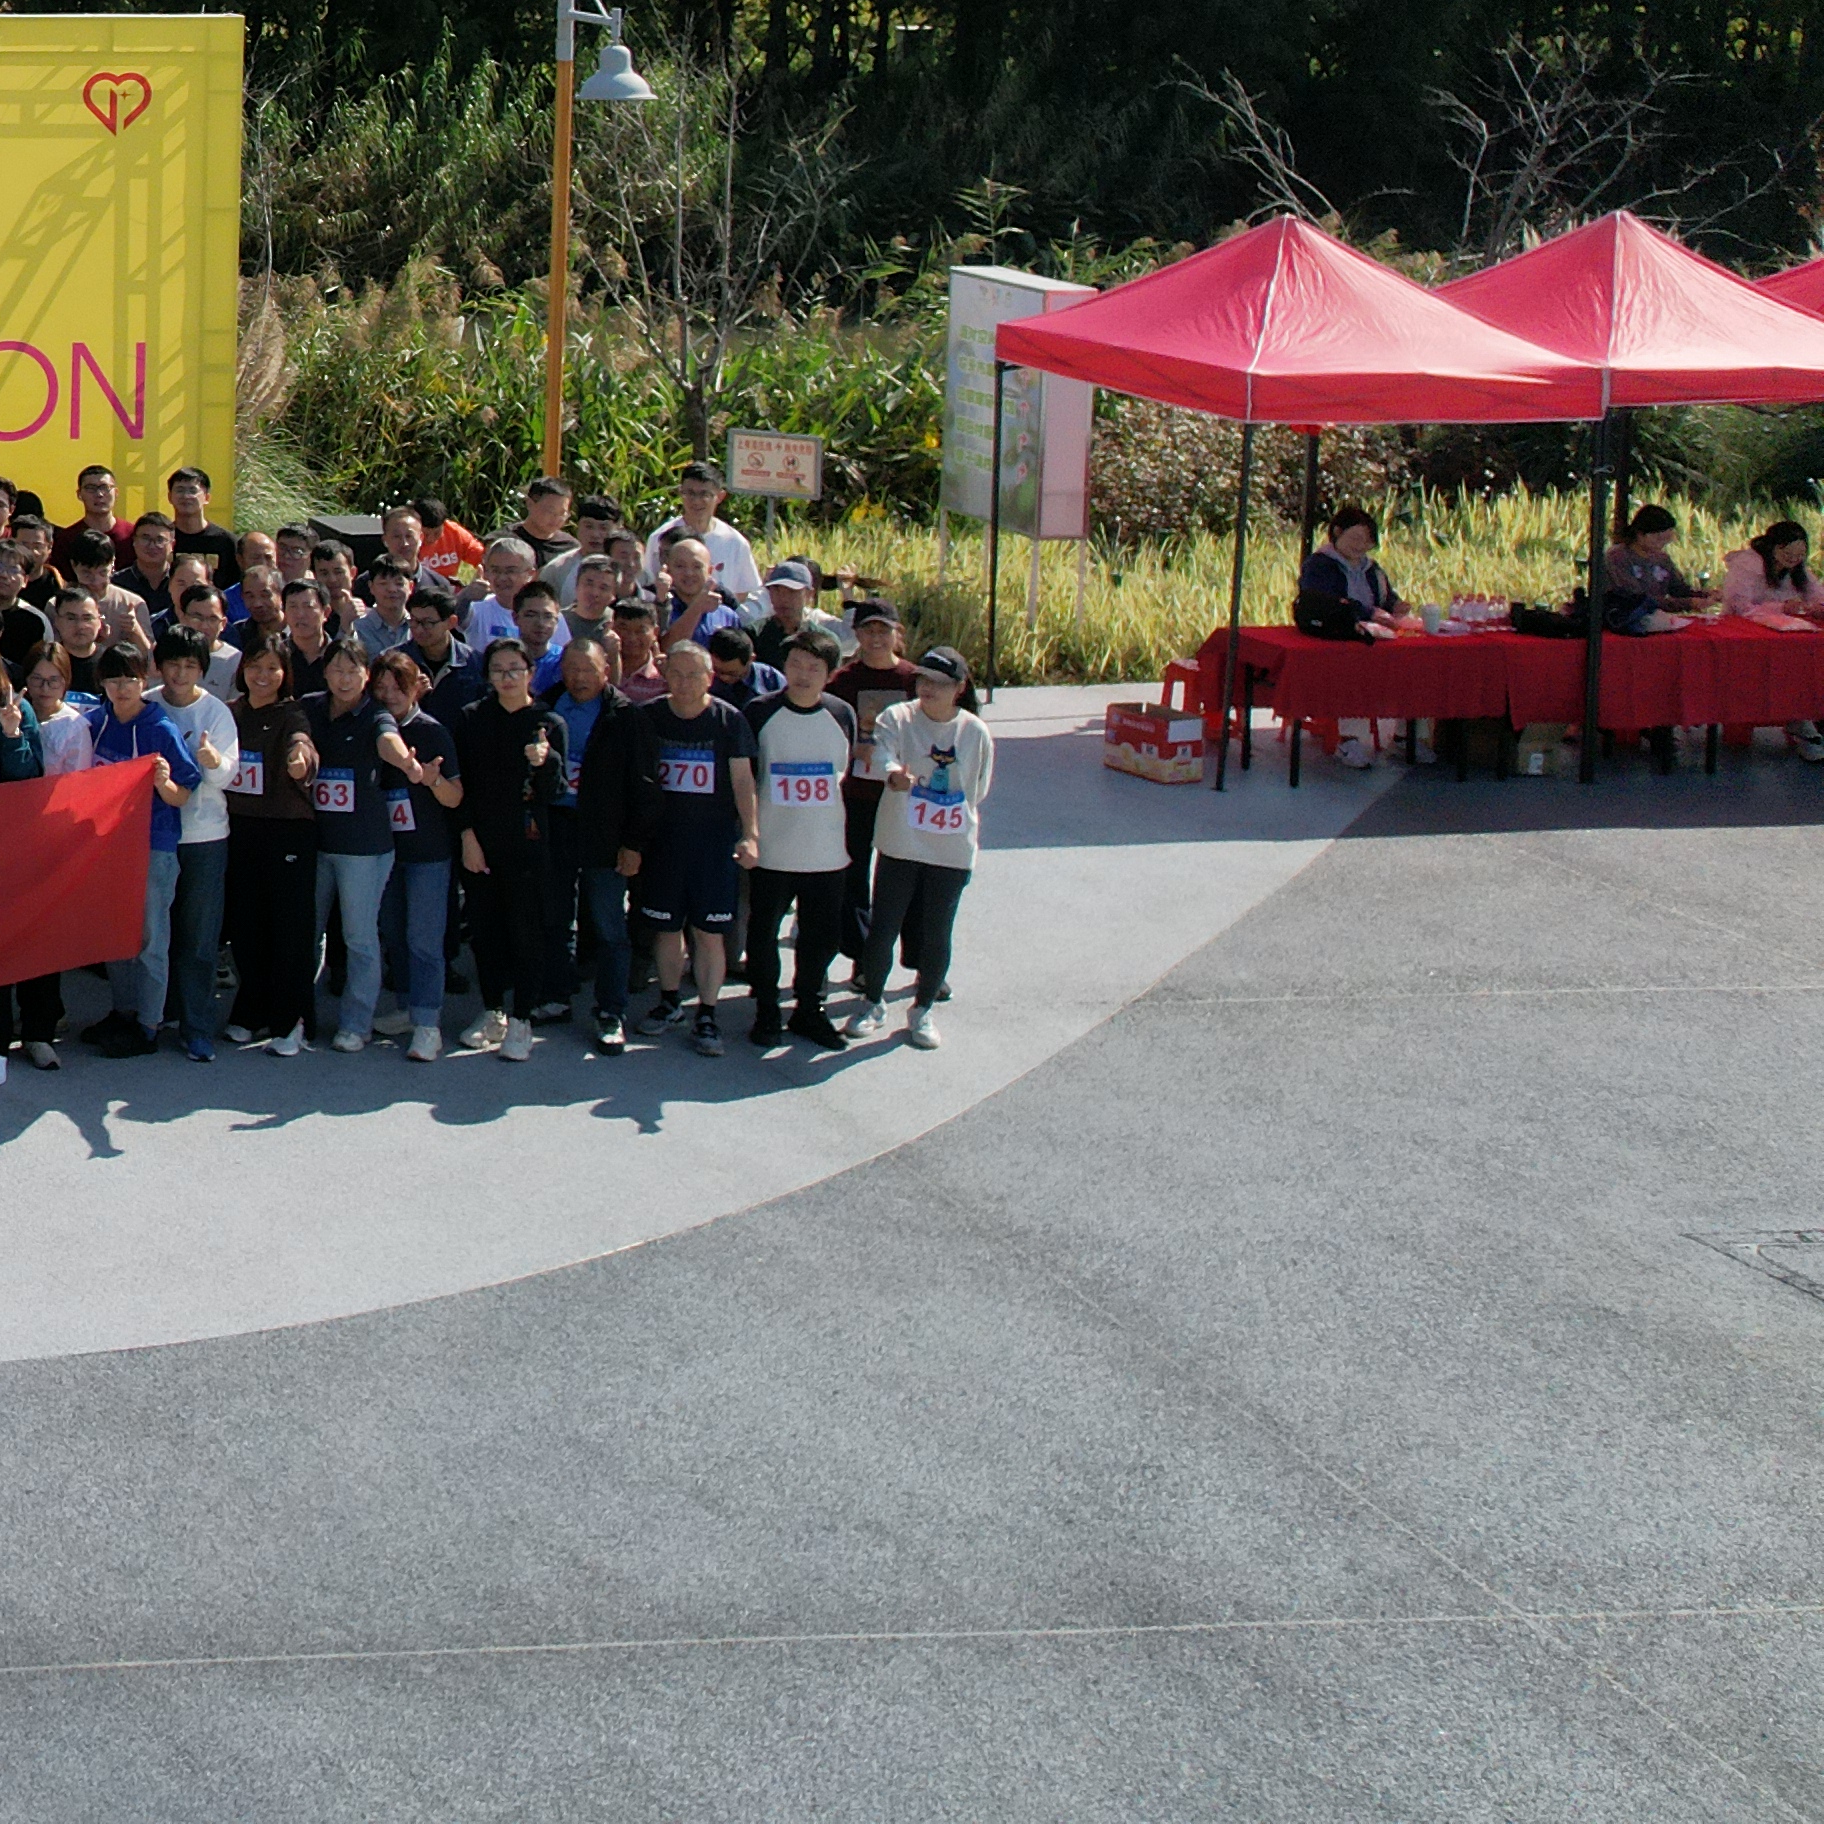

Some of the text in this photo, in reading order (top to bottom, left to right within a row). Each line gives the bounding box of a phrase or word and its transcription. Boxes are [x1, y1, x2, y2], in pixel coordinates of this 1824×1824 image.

[657, 761, 709, 787] 270
[777, 778, 830, 802] 198
[913, 801, 963, 829] 145
